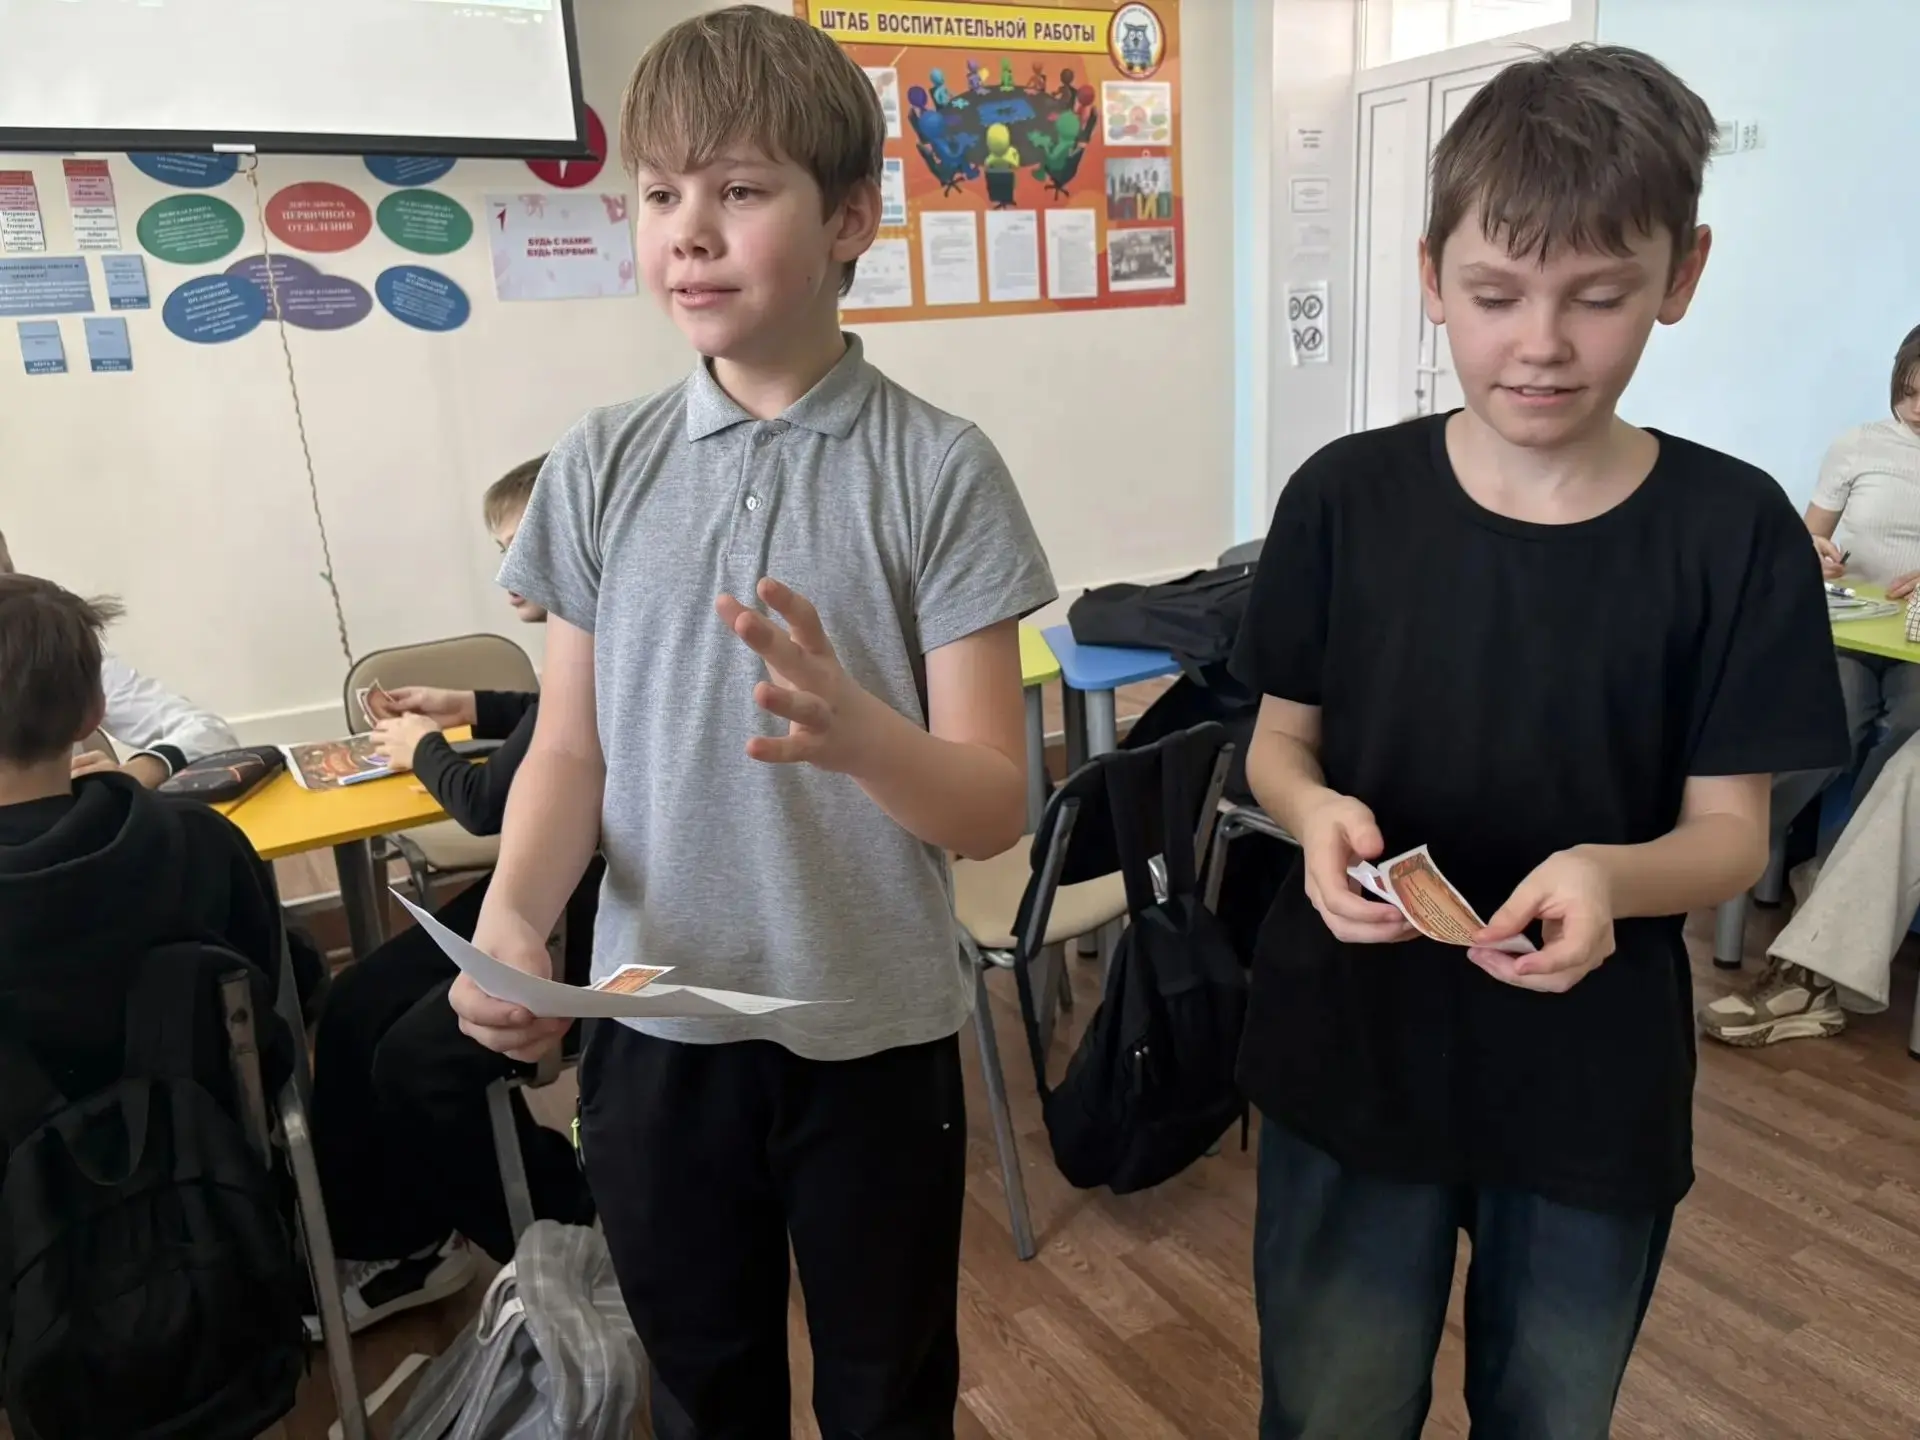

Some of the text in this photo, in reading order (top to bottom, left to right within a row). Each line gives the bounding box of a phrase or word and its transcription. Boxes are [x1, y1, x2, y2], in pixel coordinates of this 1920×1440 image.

[820, 10, 869, 31] ШТАБ
[877, 13, 1026, 39] ВОСПИТАТЕЛЬНОЙ
[1034, 22, 1095, 42] РАБОТЫ
[282, 210, 356, 220] ПЕРВИЧНОГО
[528, 238, 552, 246] БУДЬ
[527, 247, 597, 257] БУДЬ ПЕРВЫМ!
